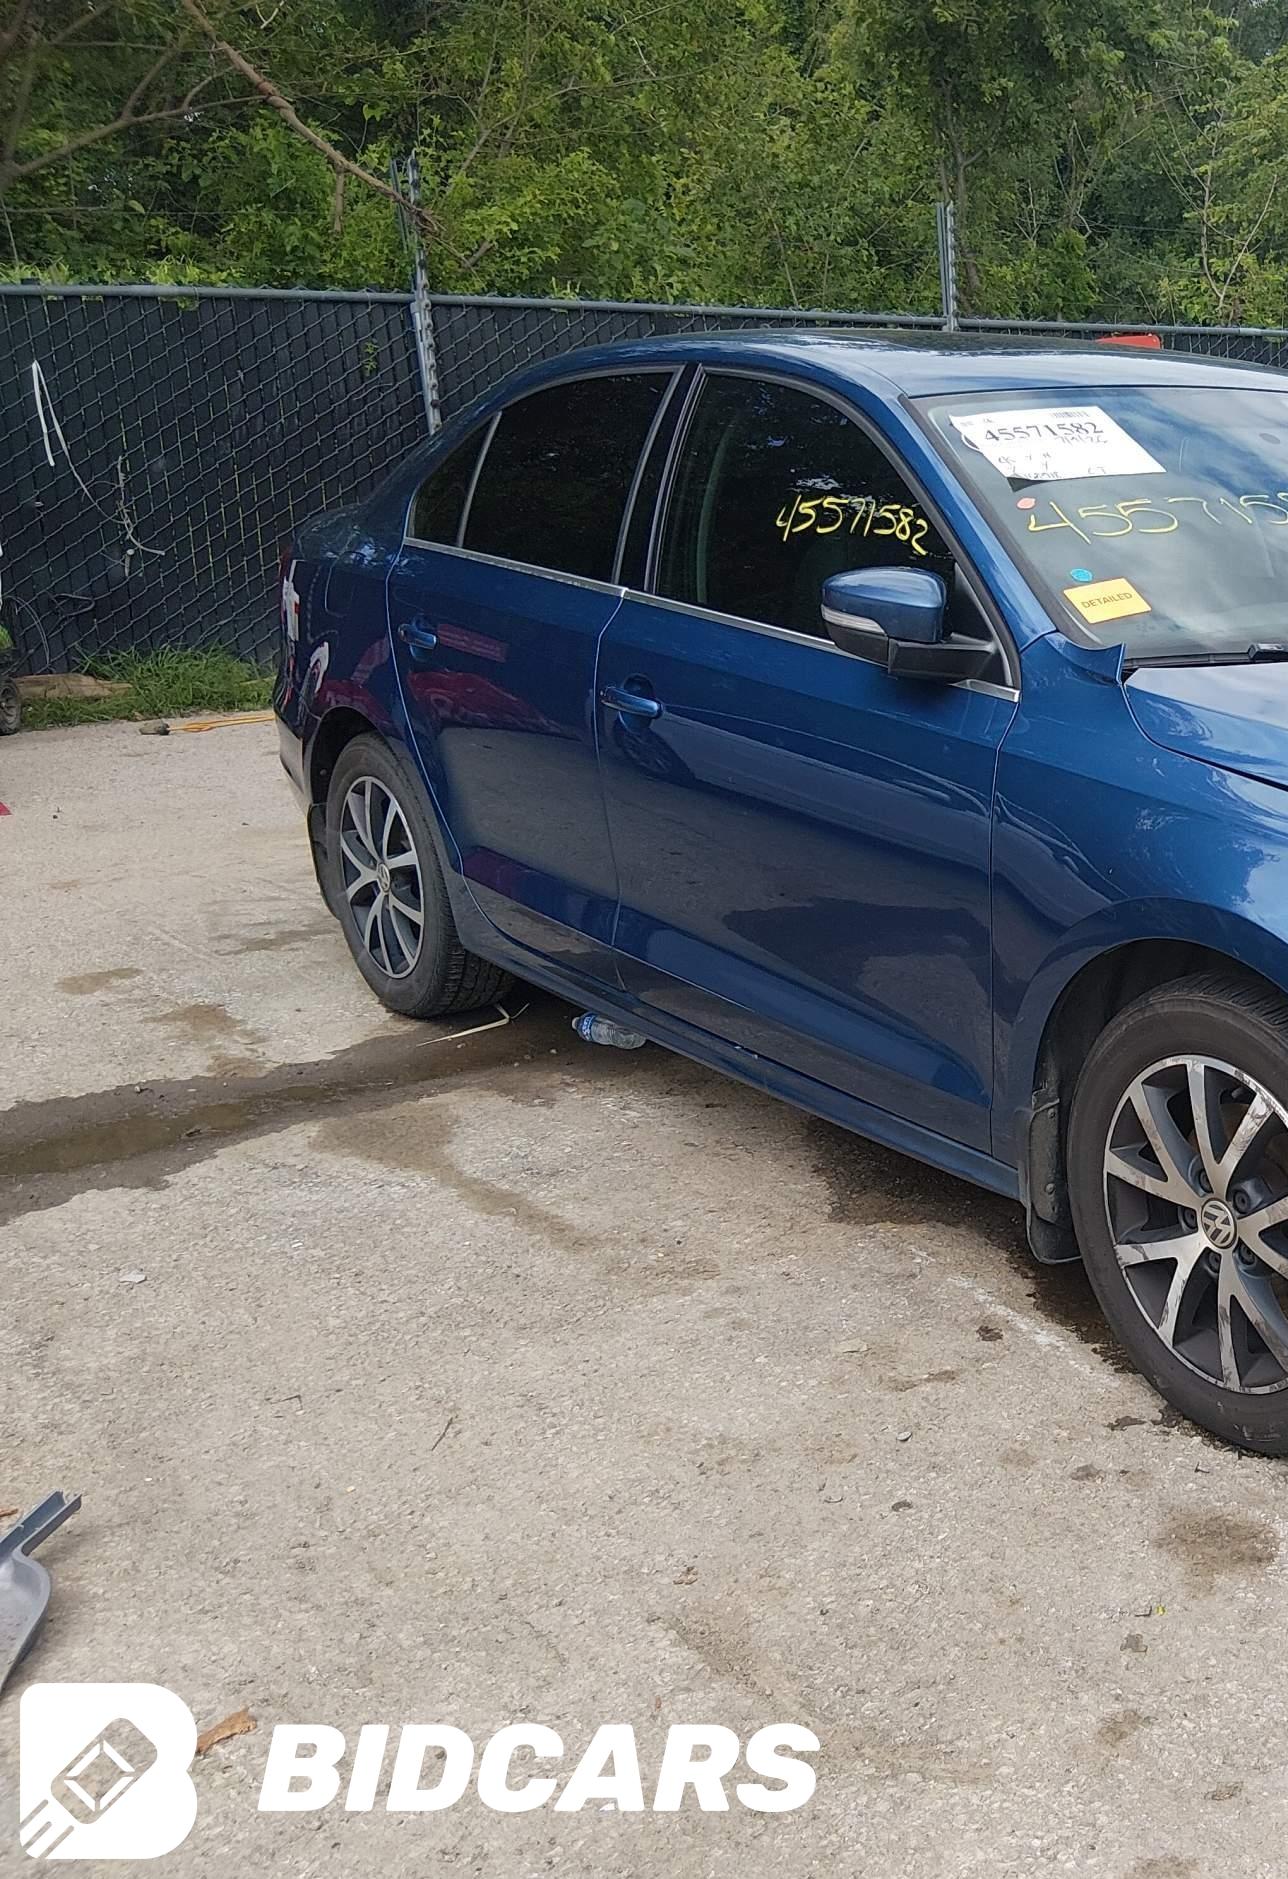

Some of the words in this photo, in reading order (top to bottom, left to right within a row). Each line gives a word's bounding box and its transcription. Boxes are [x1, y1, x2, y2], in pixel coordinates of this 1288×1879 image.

[985, 421, 1105, 442] 45571582
[775, 494, 929, 556] 45571582
[1081, 592, 1134, 609] DETAILED
